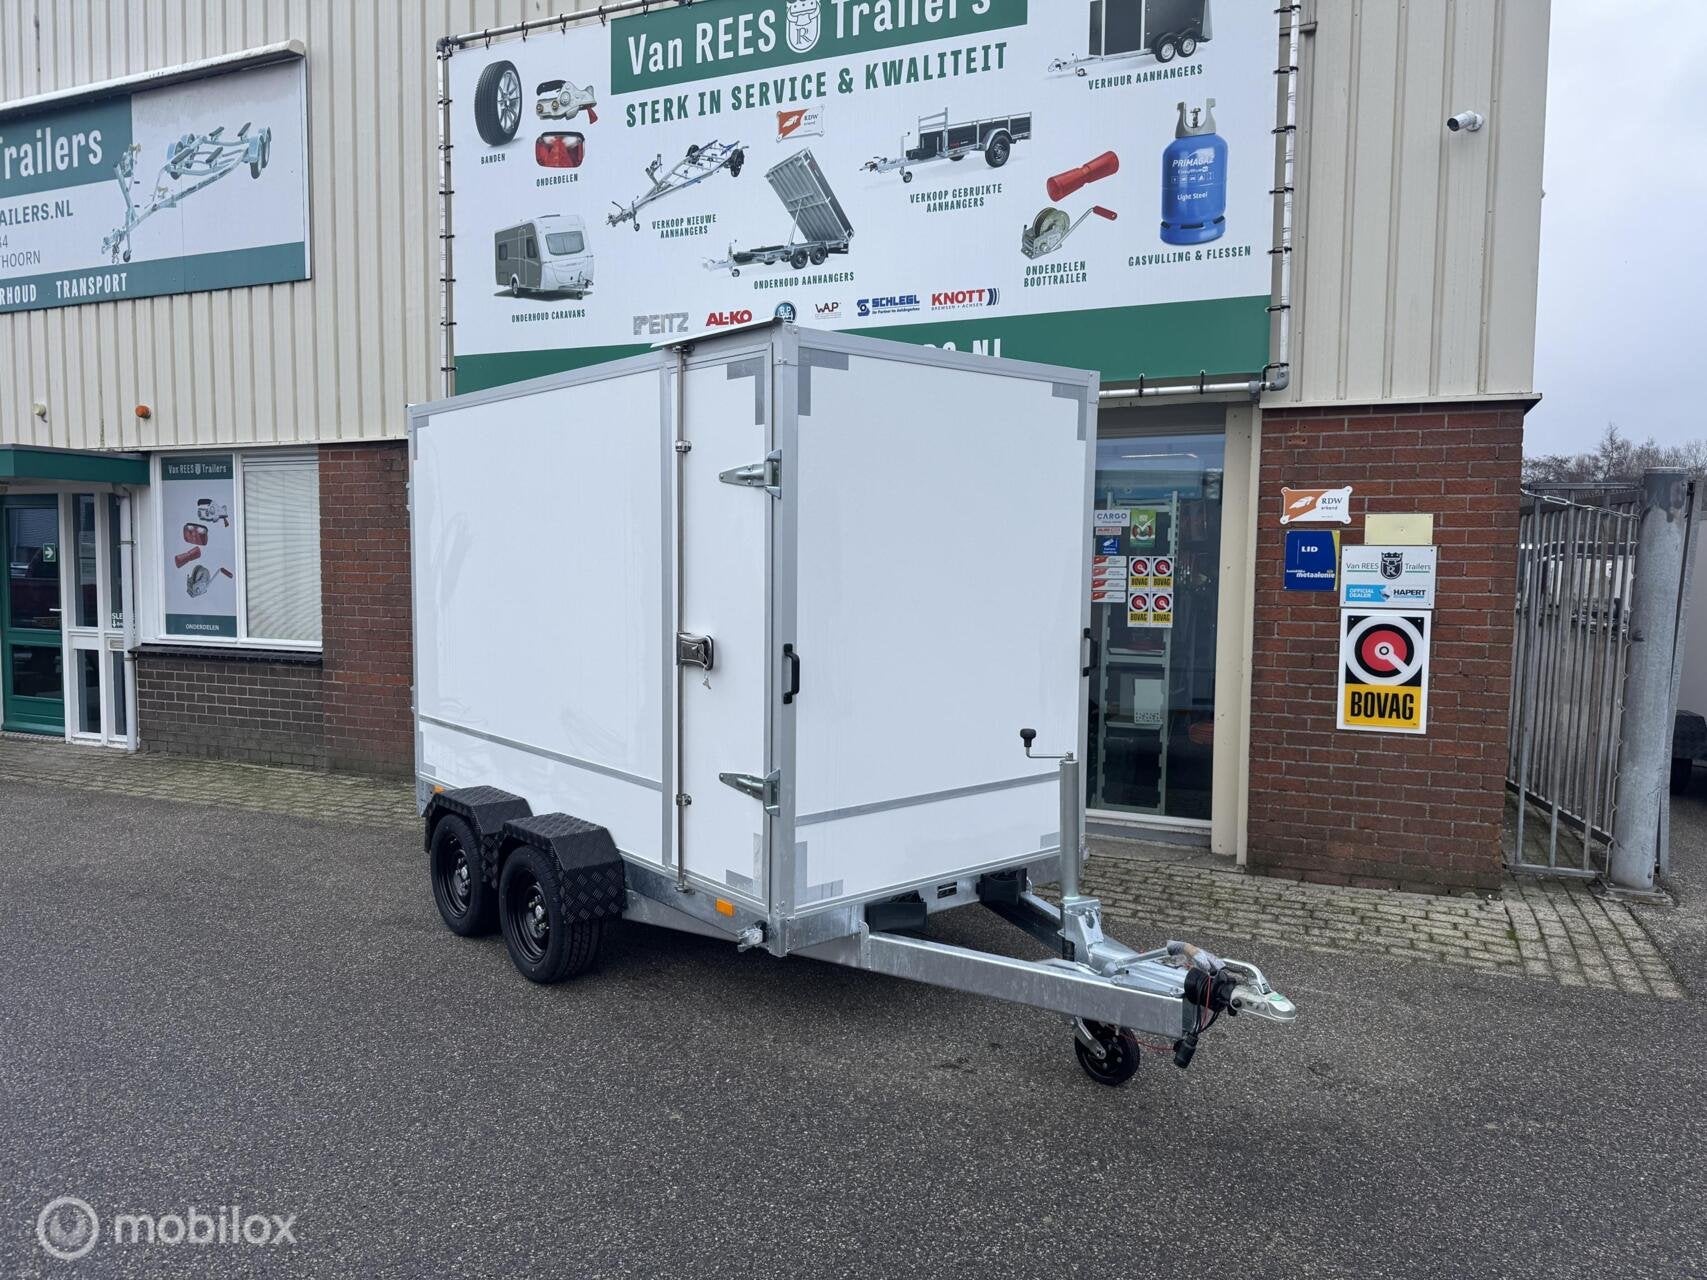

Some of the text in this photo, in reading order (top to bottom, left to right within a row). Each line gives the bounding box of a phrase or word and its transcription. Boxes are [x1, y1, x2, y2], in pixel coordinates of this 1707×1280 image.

[628, 9, 776, 75] Van REES
[627, 42, 1007, 127] STERK IN SERVICE & KWALITEIT
[1088, 64, 1203, 90] VERHUUR AANHANGERS
[0, 127, 102, 179] railers
[481, 153, 506, 165] BANDEN
[536, 173, 578, 187] ONDERDELEN
[910, 183, 1003, 203] VERKOOP GEBRUIKTE
[1177, 191, 1208, 202] Light Steel
[926, 197, 985, 213] AANHANGERS
[652, 214, 717, 230] VERKOOP NIEUWE
[660, 225, 708, 238] AANHANGERS
[1128, 246, 1251, 267] GASVULLING & FLESSEN
[1025, 261, 1086, 275] ONDERDELEN
[56, 273, 127, 299] TRANSPORT
[753, 272, 855, 290] ONDERHOUD AANHANGERS
[1024, 273, 1087, 287] BOOTTRAILER
[872, 294, 920, 308] SCHLEGL
[931, 288, 986, 306] KNOTT
[511, 308, 586, 323] ONDERHOUD CARAVANS
[705, 309, 753, 327] AL-KO
[168, 463, 227, 474] Van REES Trailers
[1346, 562, 1379, 570] Van REES
[1131, 577, 1149, 586] BOVAG
[1153, 578, 1171, 586] BOVAG
[1130, 612, 1147, 622] BOVAG
[1152, 613, 1171, 622] BOVAG
[1350, 690, 1414, 721] BOVAG
